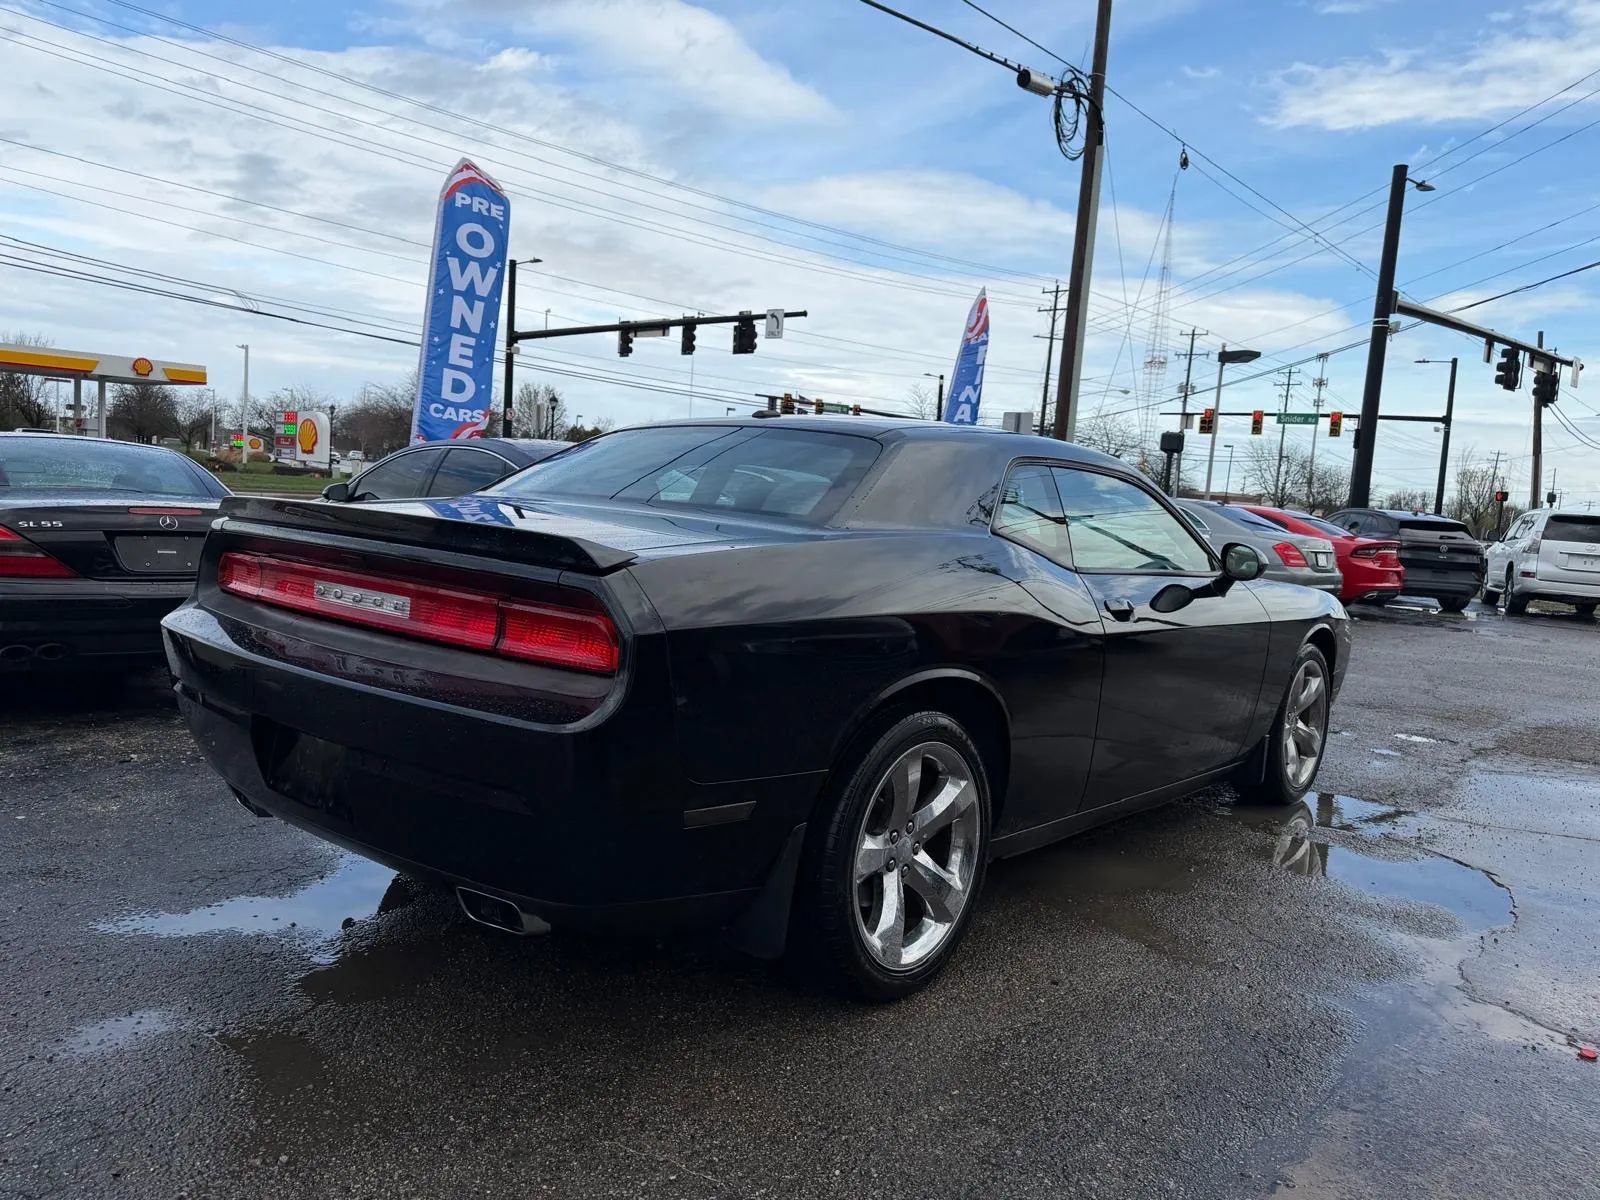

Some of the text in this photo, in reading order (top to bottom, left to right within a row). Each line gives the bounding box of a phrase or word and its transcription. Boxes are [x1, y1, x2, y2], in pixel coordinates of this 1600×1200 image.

[455, 191, 504, 221] PRE
[440, 222, 498, 403] OWNED
[429, 402, 485, 423] CARS
[1280, 414, 1305, 423] Snider
[316, 585, 407, 612] DODGE
